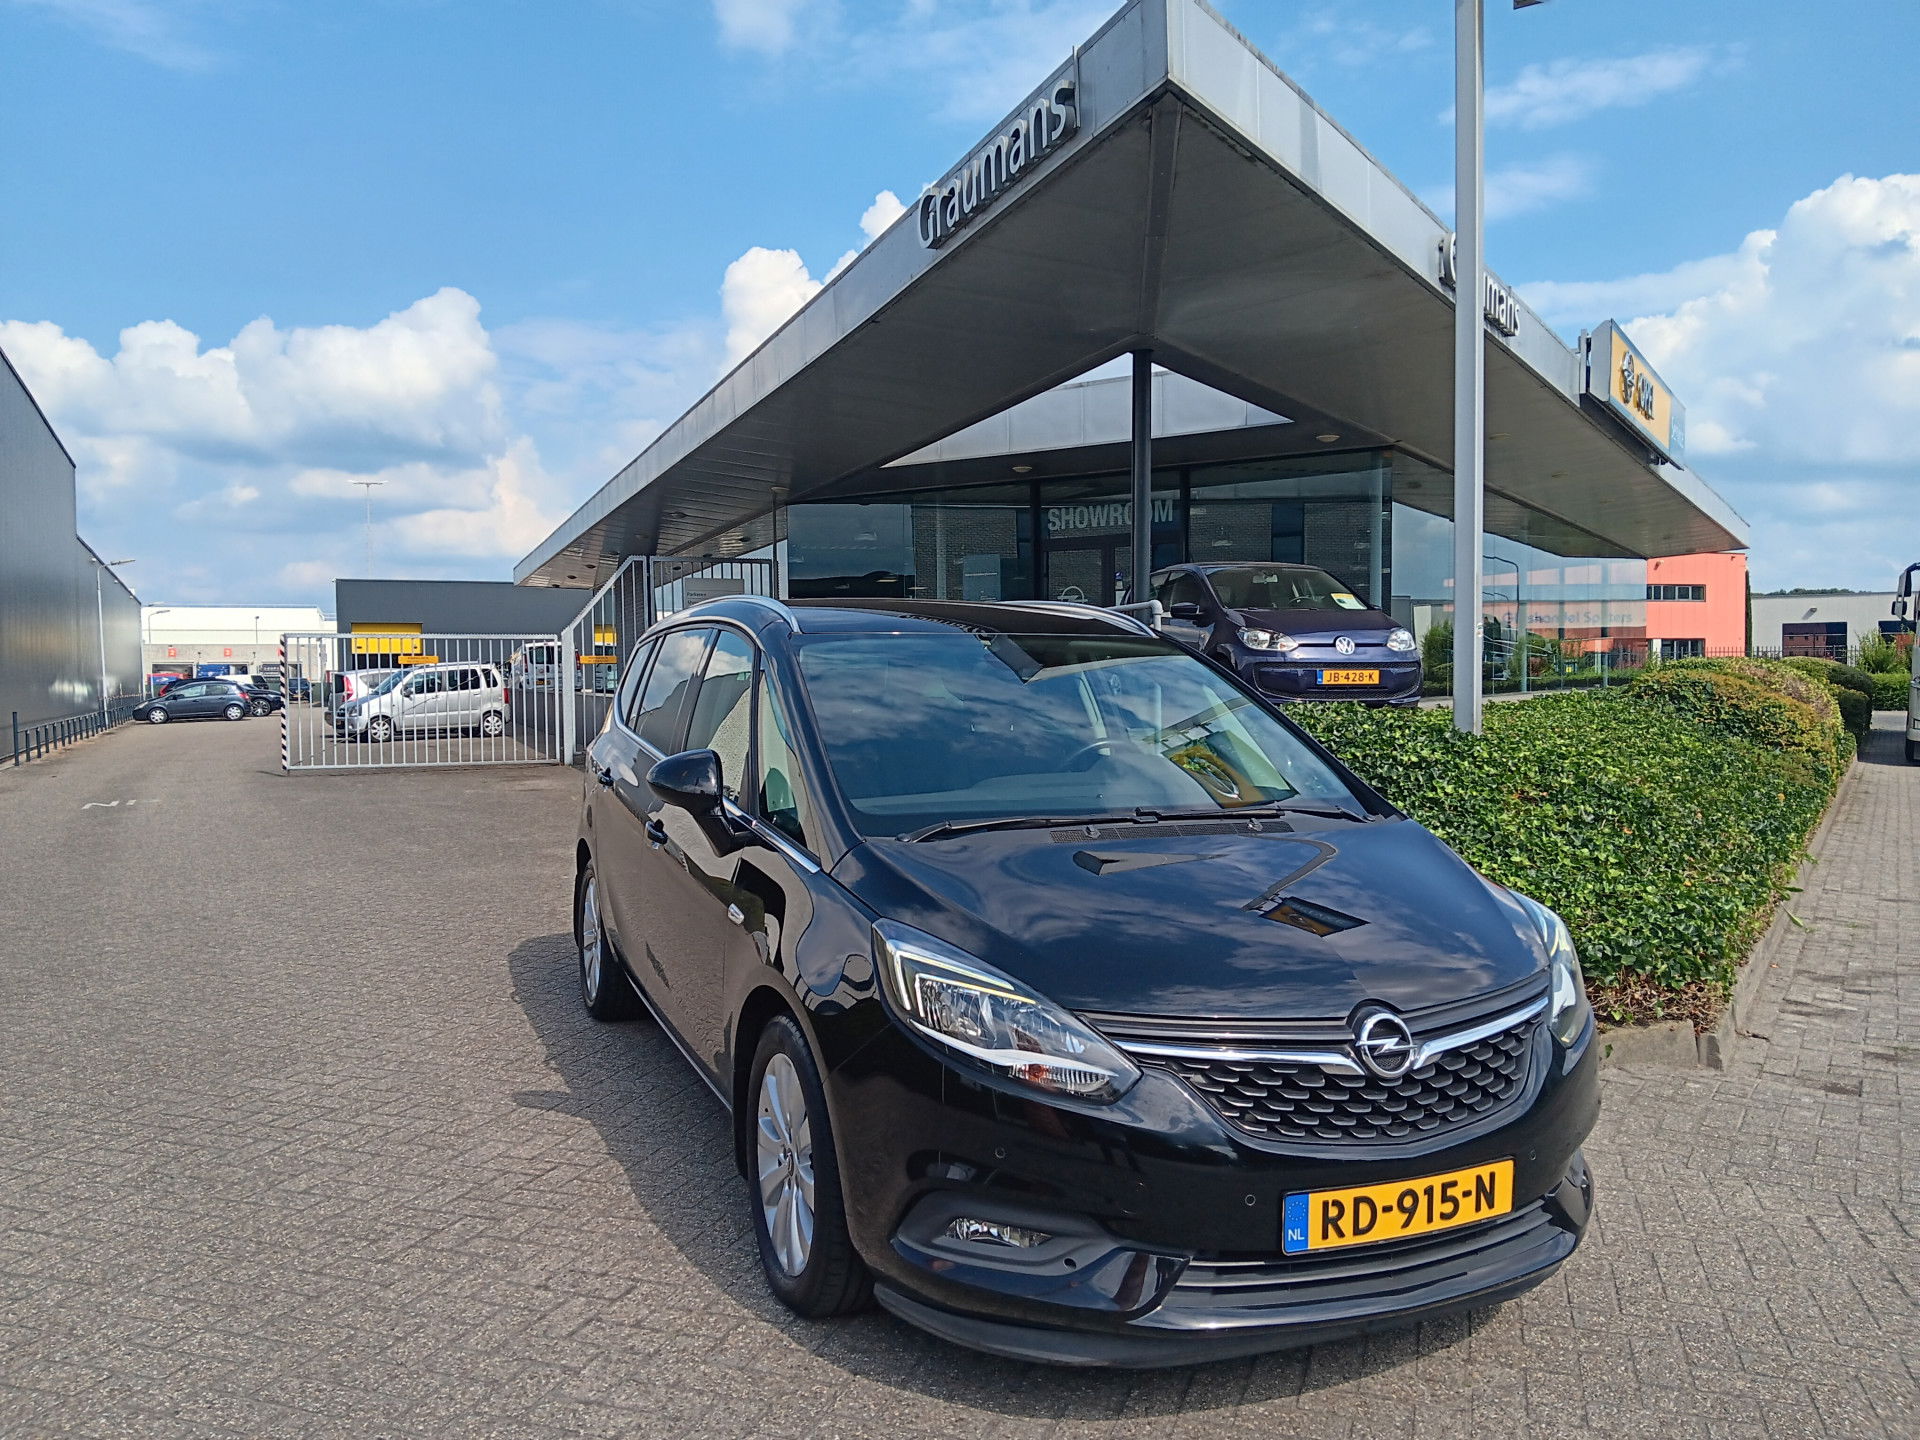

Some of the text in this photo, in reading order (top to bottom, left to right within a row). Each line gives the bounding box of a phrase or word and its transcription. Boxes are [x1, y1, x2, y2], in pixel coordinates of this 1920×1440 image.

[918, 79, 1076, 249] Graumans
[1048, 499, 1173, 531] SHOWROM
[1326, 672, 1374, 683] JB-428-K
[1320, 1171, 1496, 1241] RD-915-N
[1287, 1227, 1305, 1242] NL
